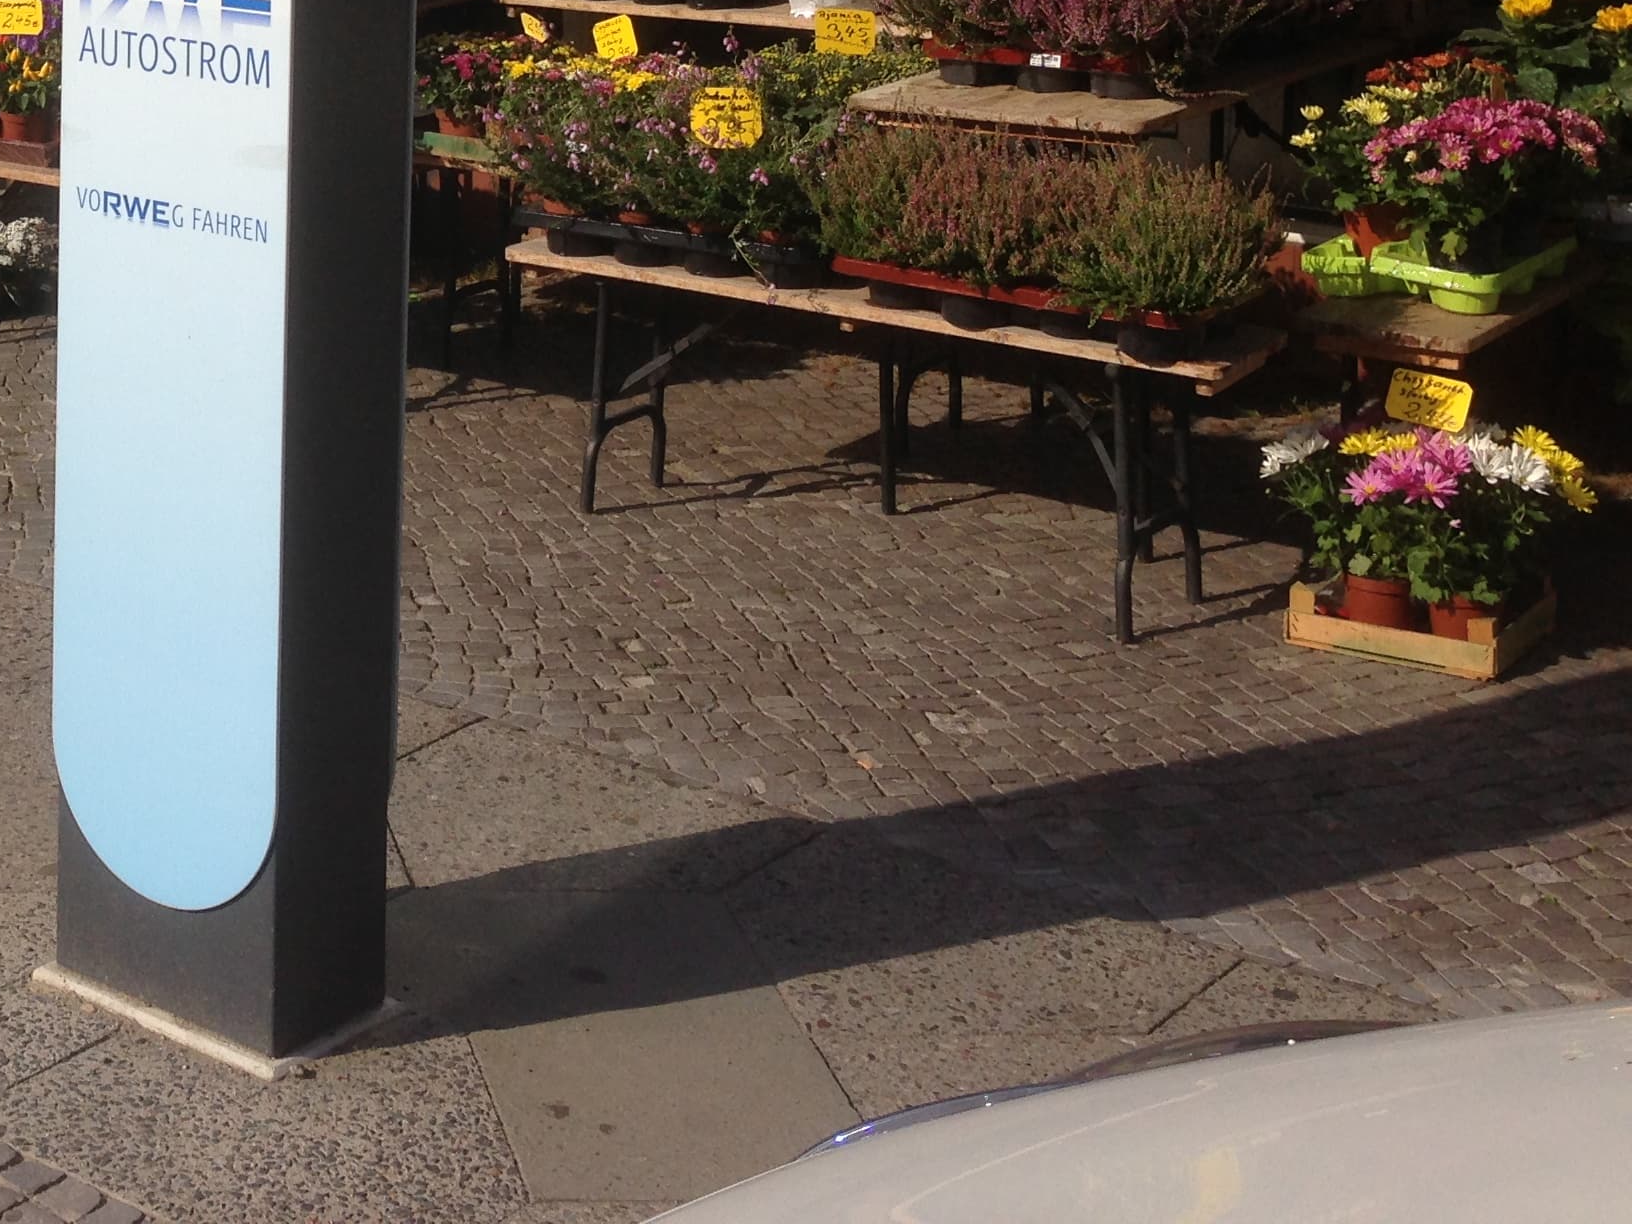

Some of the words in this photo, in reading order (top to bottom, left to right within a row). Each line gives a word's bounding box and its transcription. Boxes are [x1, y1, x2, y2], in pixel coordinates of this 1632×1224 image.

[78, 25, 271, 89] AUTOSTROM
[76, 186, 184, 229] VORWEG
[192, 206, 268, 244] FAHREN
